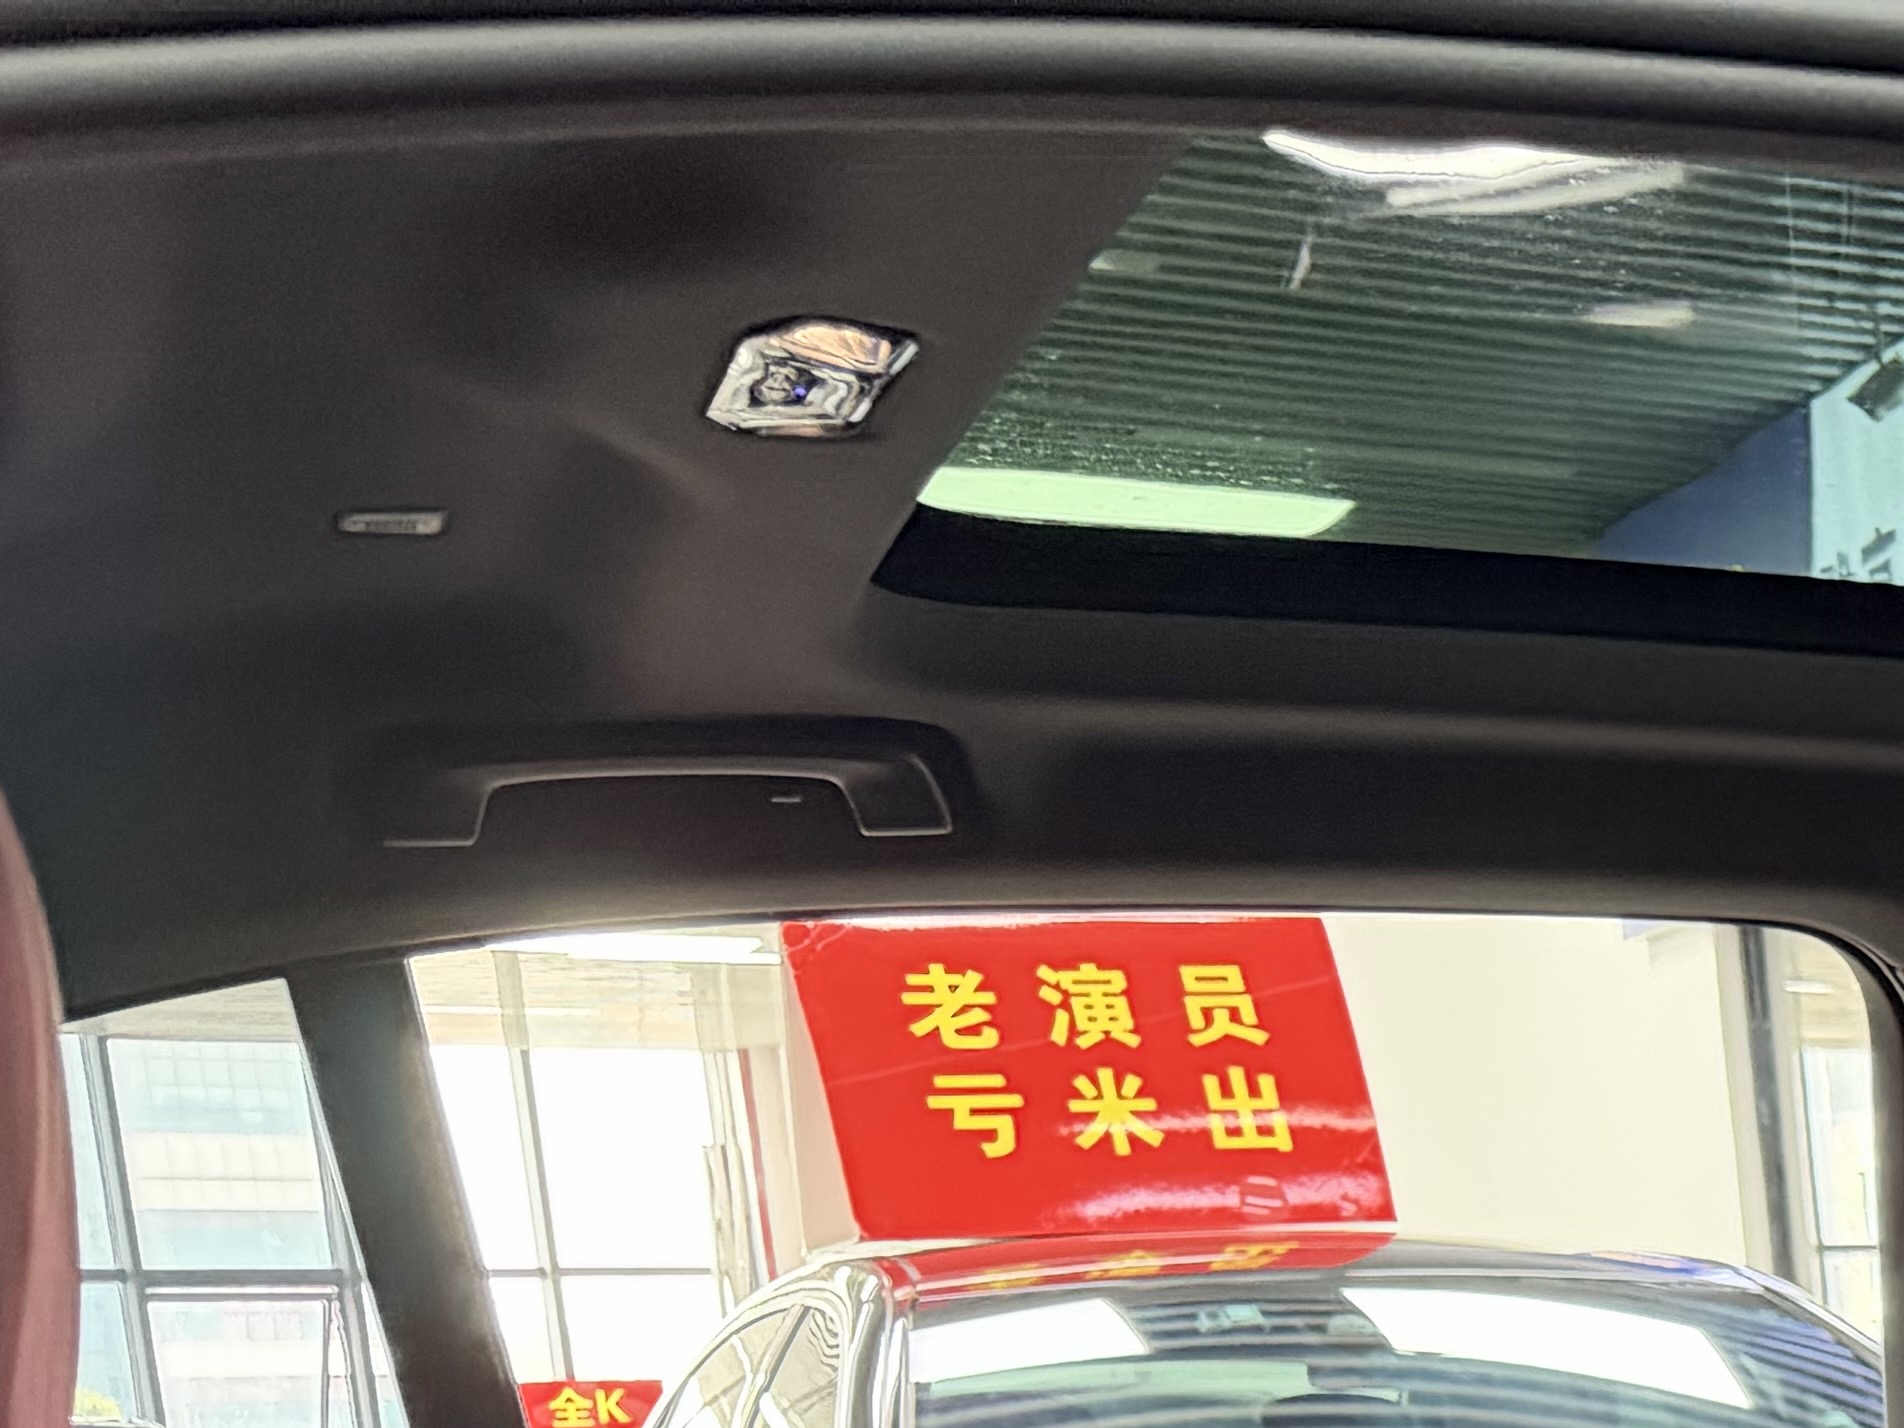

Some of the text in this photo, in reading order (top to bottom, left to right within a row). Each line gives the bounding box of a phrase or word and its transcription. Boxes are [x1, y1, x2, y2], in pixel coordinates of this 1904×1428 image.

[901, 962, 1270, 1050] 老演员
[926, 1065, 1294, 1159] 亏米出
[548, 1386, 634, 1428] 全K
